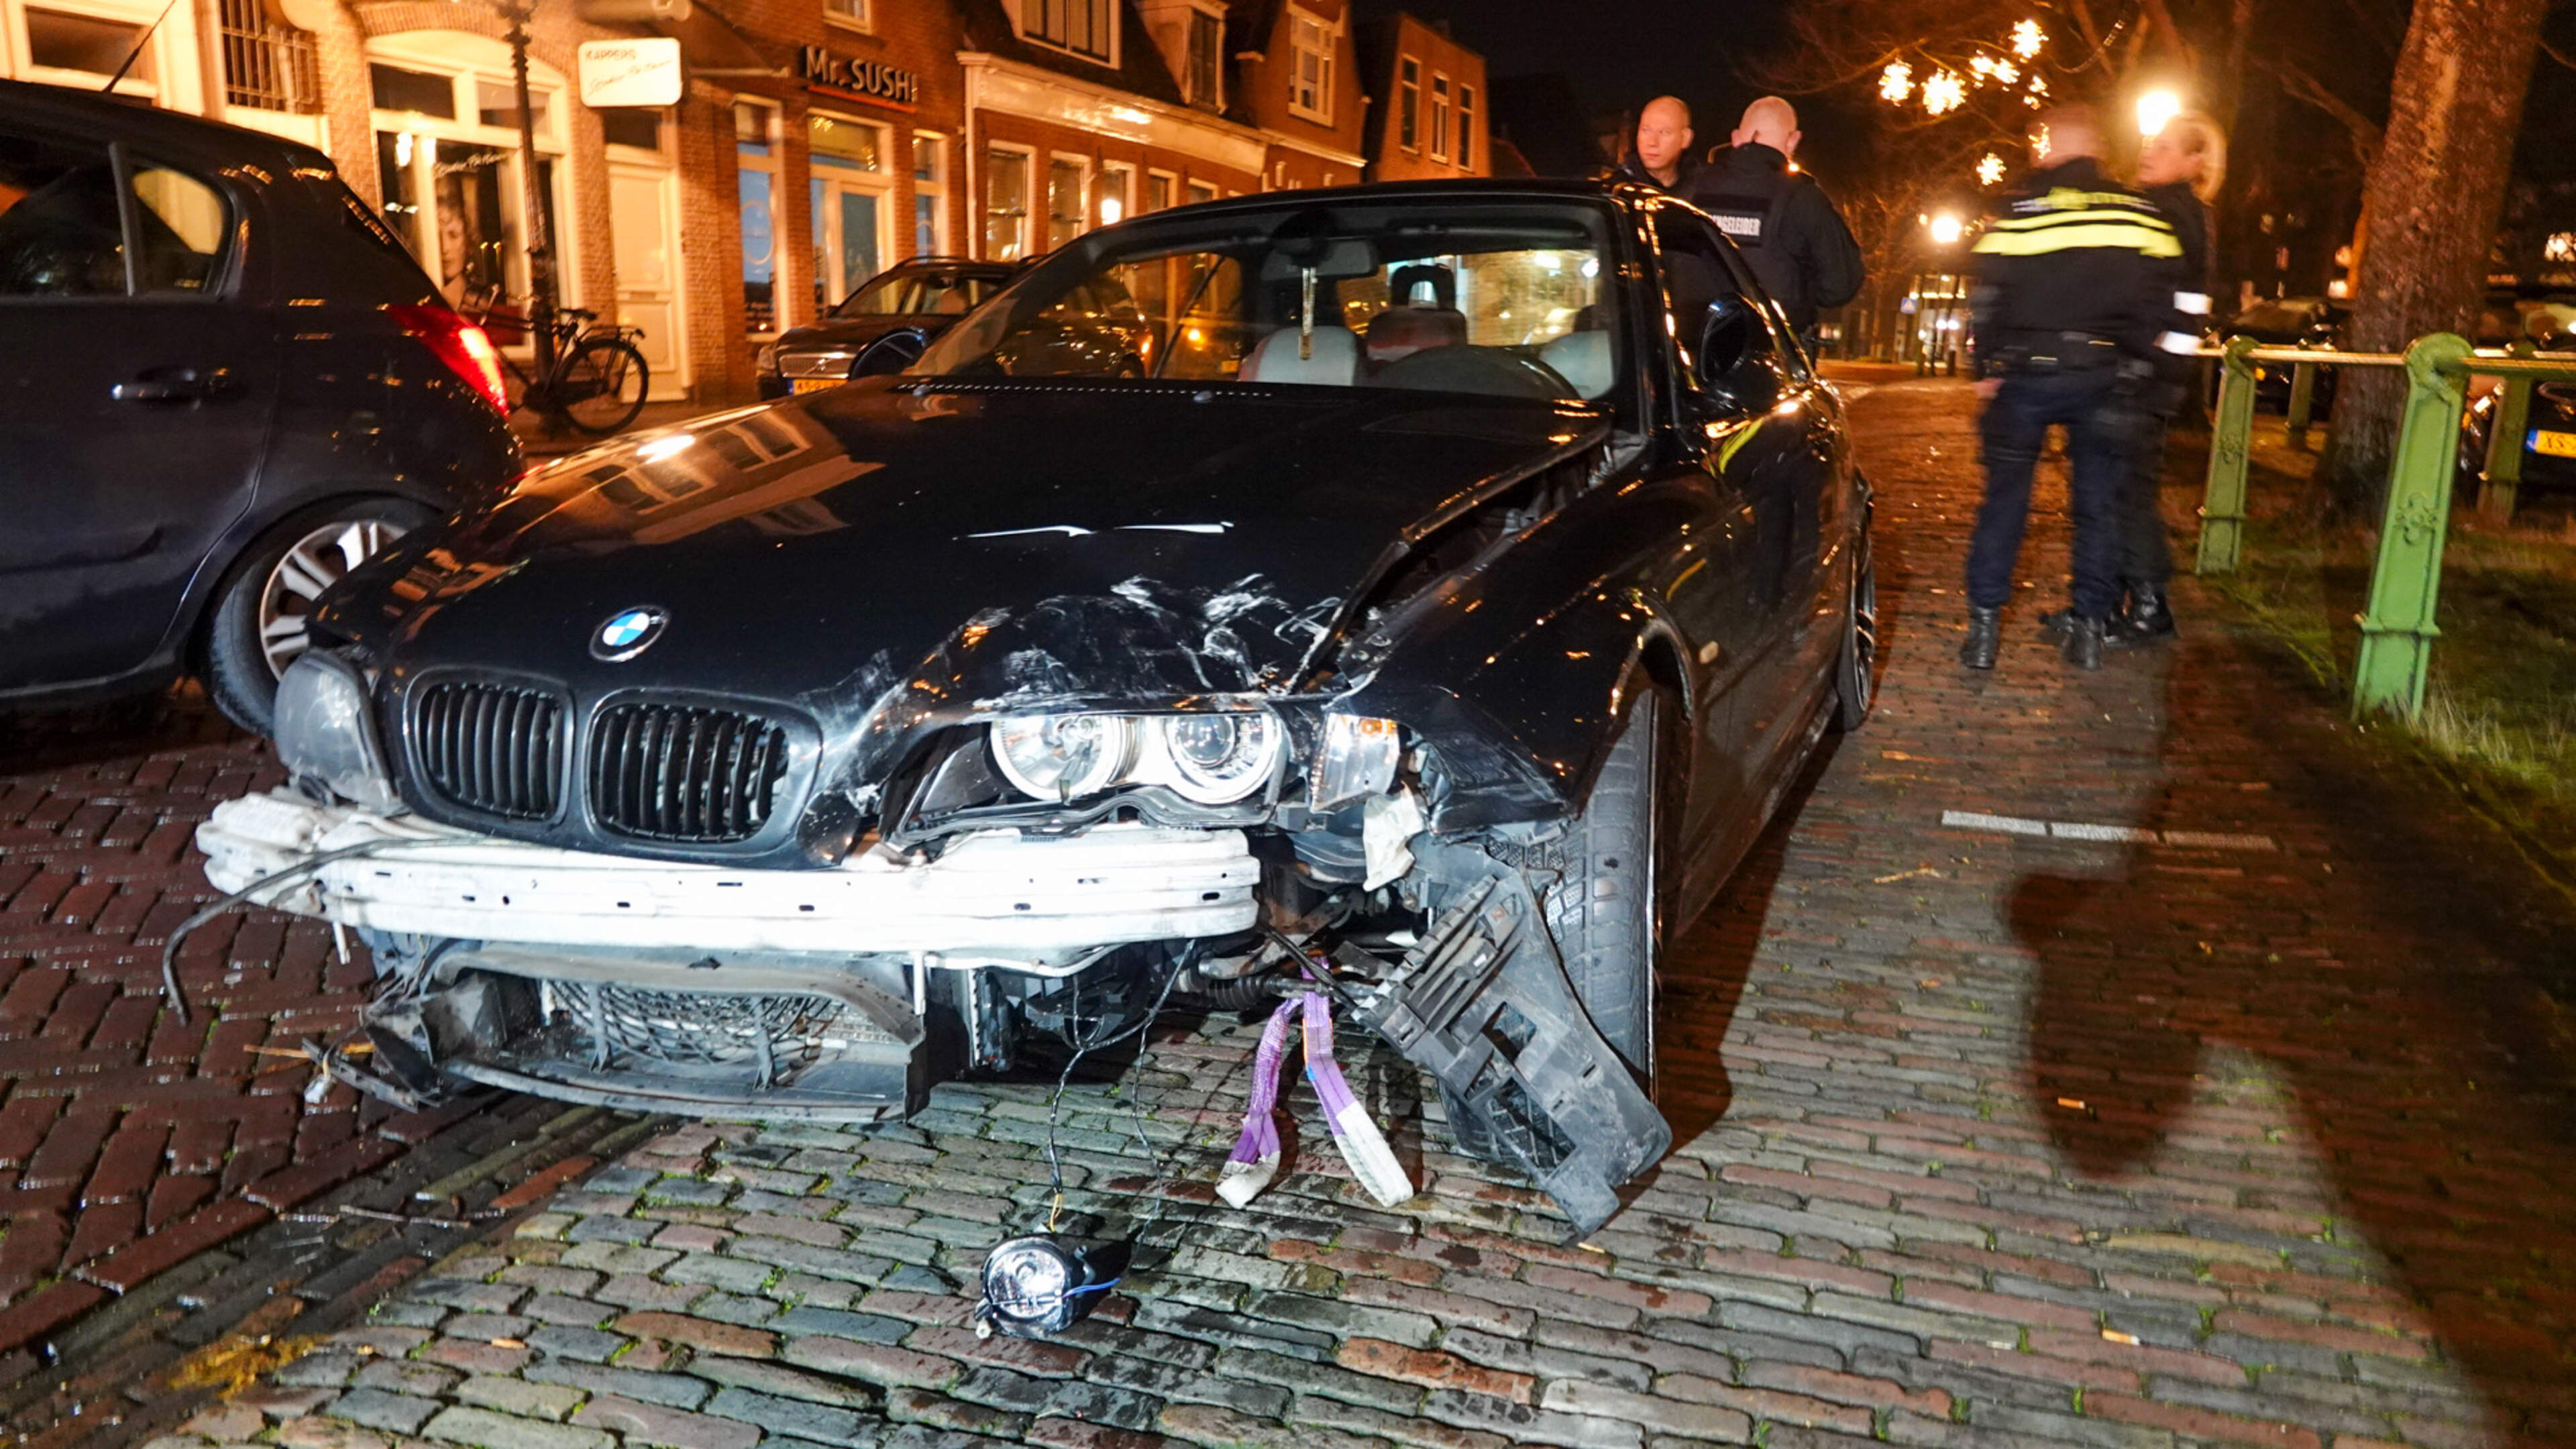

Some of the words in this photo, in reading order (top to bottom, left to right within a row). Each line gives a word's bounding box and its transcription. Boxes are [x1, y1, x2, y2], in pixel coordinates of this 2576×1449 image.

[585, 49, 637, 61] KAPPERS
[806, 46, 846, 87] Mr.
[851, 58, 918, 103] SUSHI
